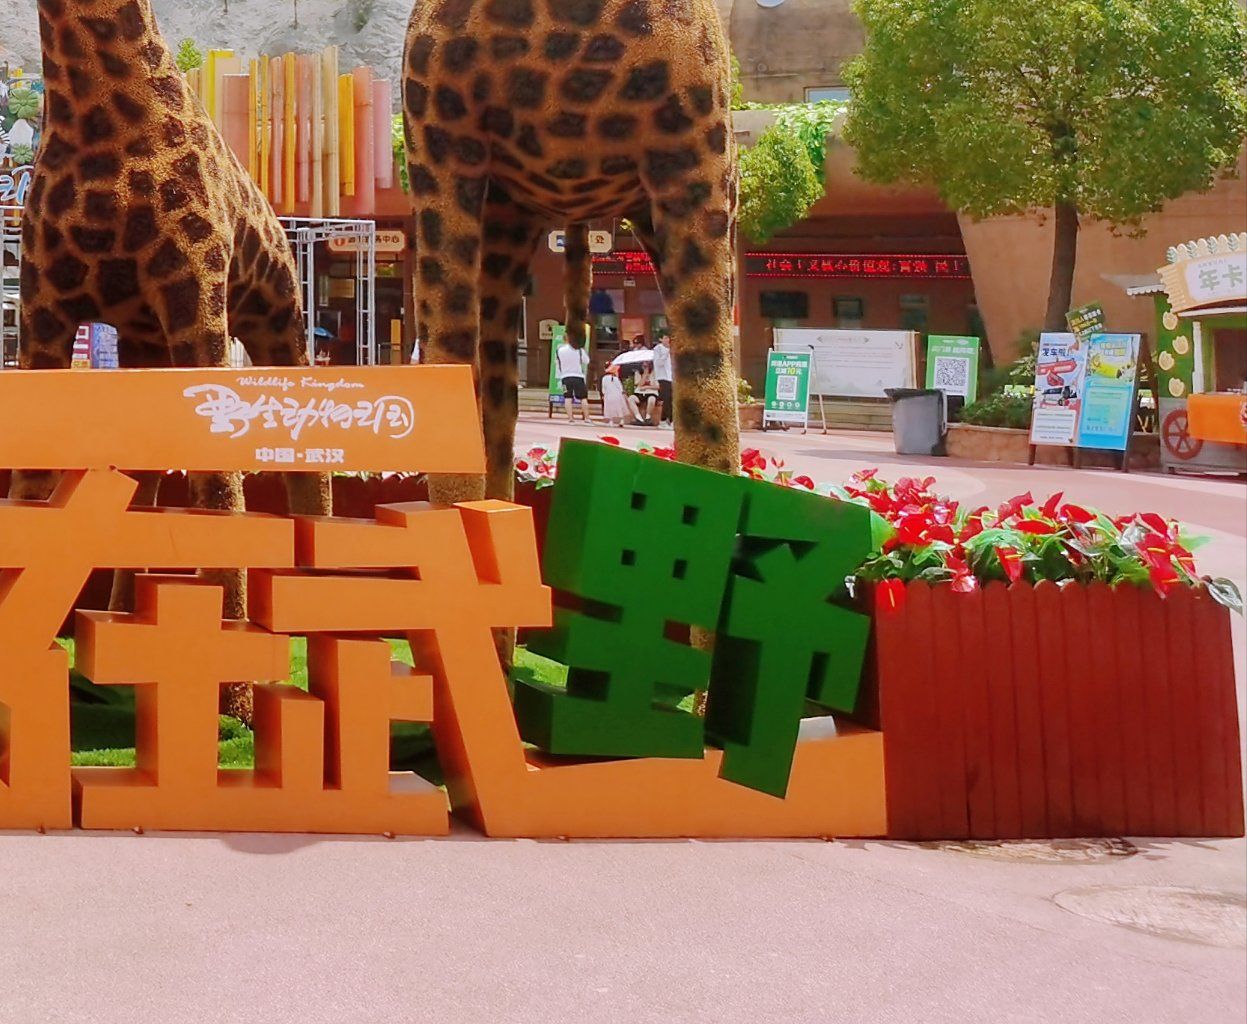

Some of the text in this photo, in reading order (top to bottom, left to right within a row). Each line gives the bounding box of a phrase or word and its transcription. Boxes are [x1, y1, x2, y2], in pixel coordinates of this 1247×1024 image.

[1198, 264, 1244, 291] 年卡
[236, 376, 365, 392] Wildlife Kingdom
